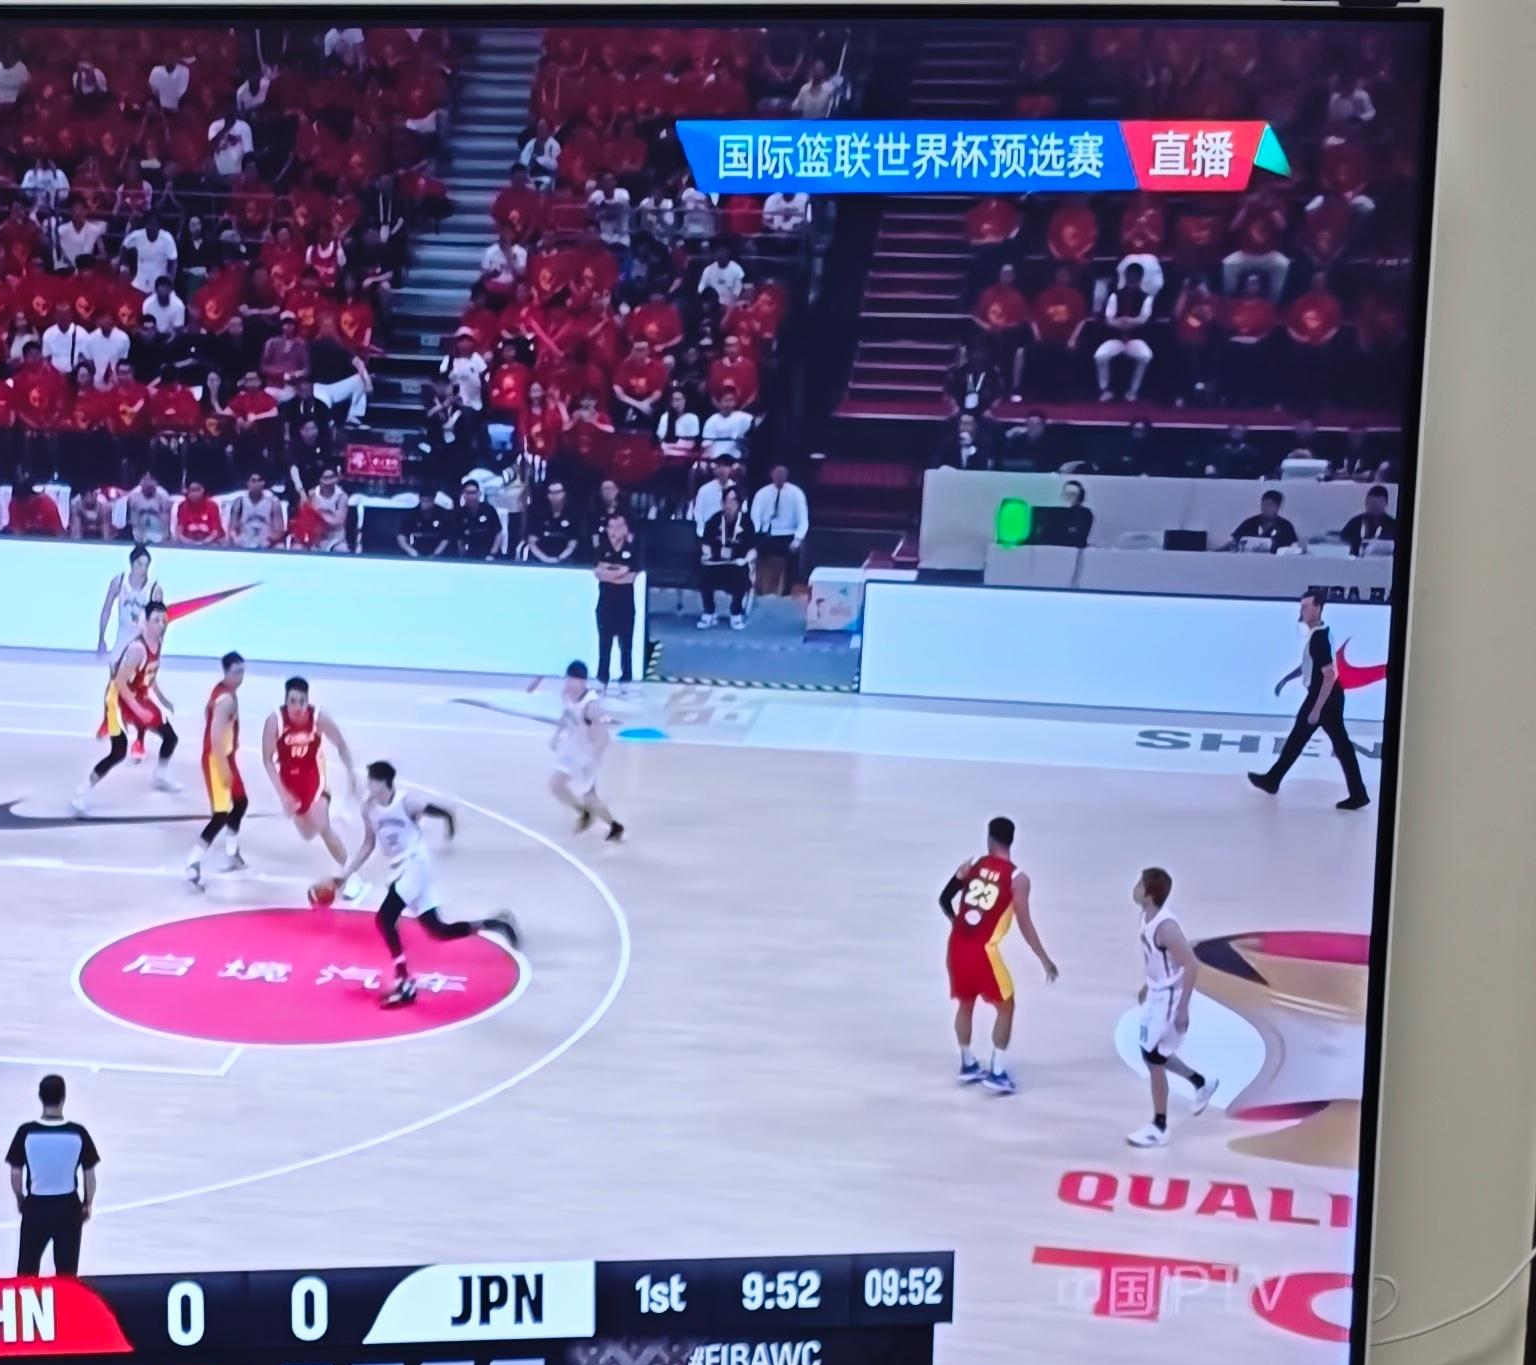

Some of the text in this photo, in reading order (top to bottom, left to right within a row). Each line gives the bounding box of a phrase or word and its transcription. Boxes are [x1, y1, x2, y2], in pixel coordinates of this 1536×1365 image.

[718, 130, 1234, 180] 国际篮联世界杯预选赛 直播
[965, 879, 999, 910] 23
[291, 1275, 329, 1342] 0
[451, 1273, 545, 1326] JPN
[635, 1274, 687, 1315] 1st
[741, 1270, 822, 1311] 9:52
[864, 1266, 944, 1308] 09:52
[167, 1281, 205, 1347] 0
